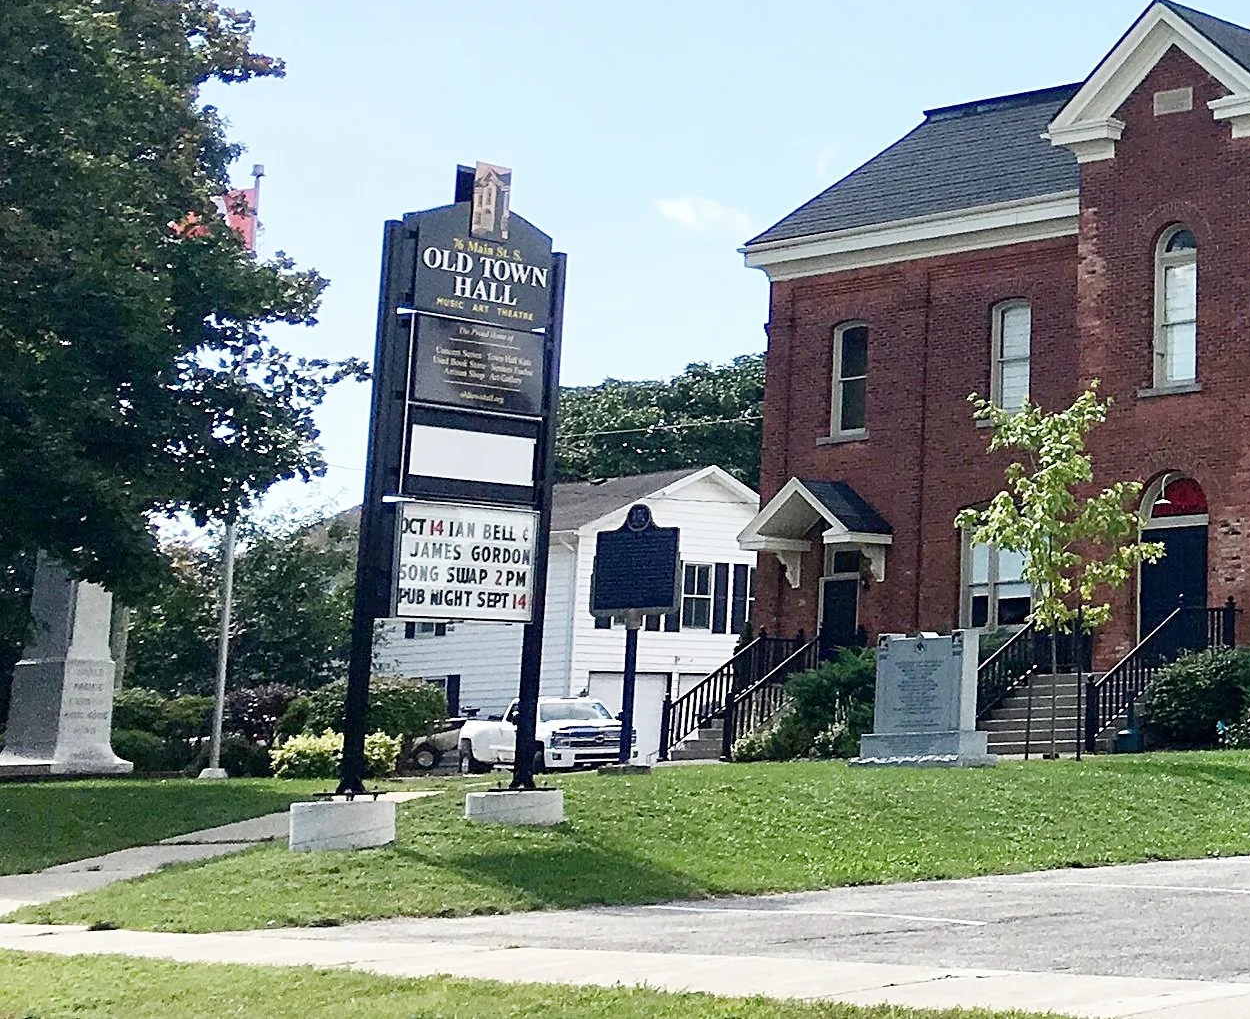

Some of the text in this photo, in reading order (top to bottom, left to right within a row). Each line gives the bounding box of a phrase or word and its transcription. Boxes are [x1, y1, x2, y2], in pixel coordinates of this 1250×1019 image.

[453, 238, 464, 250] 76
[467, 241, 494, 256] Main
[496, 246, 510, 258] St.
[423, 247, 548, 288] OLD TOWN
[454, 276, 517, 306] HALL
[436, 297, 534, 321] MUSIC ART THEATRE
[401, 517, 426, 535] OCT
[430, 519, 444, 536] 14
[449, 521, 475, 538] IAN
[483, 524, 516, 541] BELL
[410, 542, 531, 565] JAMES GORDON
[400, 564, 439, 582] SONG
[446, 566, 488, 585] SWAP
[399, 587, 527, 609] PUB NIGHT SEPT 14
